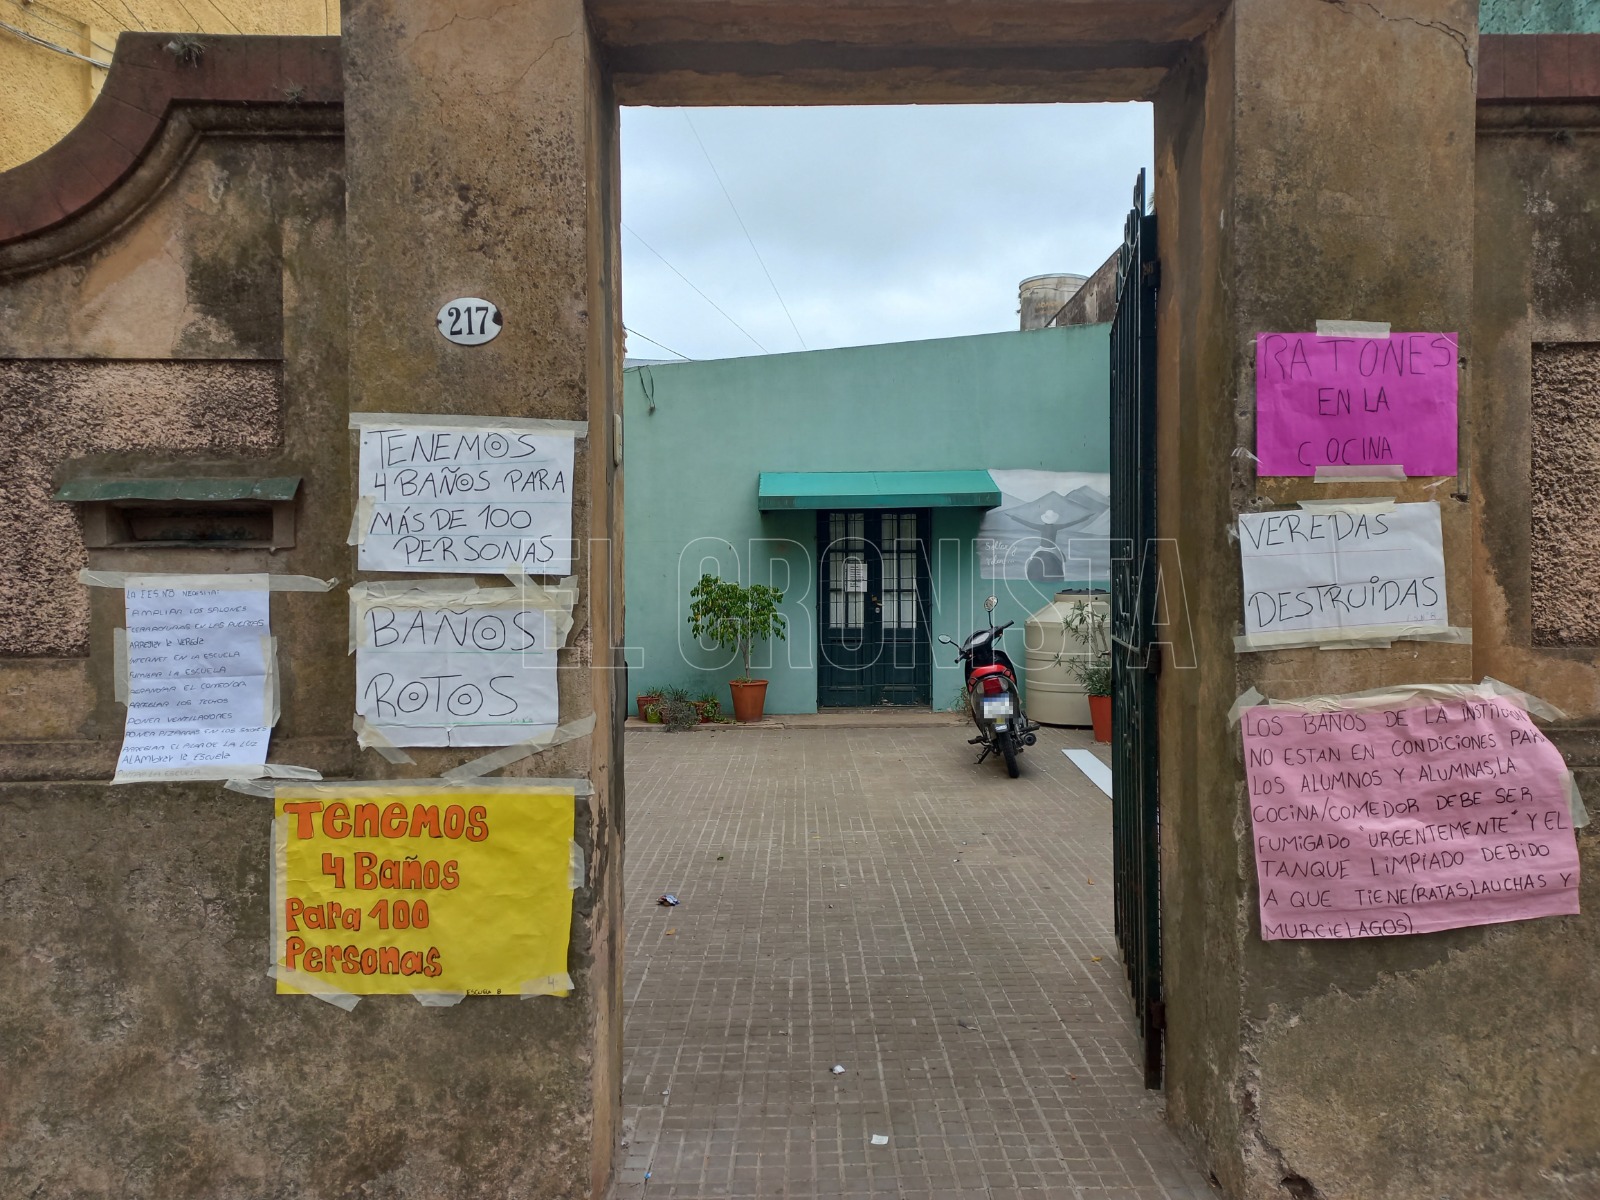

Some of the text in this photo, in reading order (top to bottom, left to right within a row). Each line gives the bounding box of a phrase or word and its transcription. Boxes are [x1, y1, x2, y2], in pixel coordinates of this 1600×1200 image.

[447, 306, 489, 336] 217
[1264, 334, 1451, 380] RATONES
[1318, 386, 1391, 416] EN LA
[367, 429, 536, 470] TENEMOS
[1297, 436, 1393, 467] COCINA
[374, 466, 566, 501] 4 BAÑOS PARA
[370, 504, 532, 535] MÁS DE 100
[1240, 510, 1389, 550] VEREDAS
[393, 534, 554, 565] PERSONAS
[207, 605, 248, 614] SALONES
[363, 605, 536, 652] BAÑOS
[185, 666, 227, 676] ESCUELA
[203, 651, 241, 660] ESCUELA
[364, 672, 519, 718] ROTOS
[127, 717, 161, 726] PONER
[1245, 711, 1284, 737] LOS
[1383, 709, 1409, 728] DE
[1425, 705, 1448, 725] LA
[1250, 748, 1274, 768] NO
[1284, 746, 1341, 766] ESTAN
[1351, 743, 1375, 761] EN
[1253, 775, 1285, 796] LOS
[1301, 769, 1383, 793] ALUMNOS
[1393, 767, 1405, 784] Y
[1436, 791, 1482, 811] DEBE
[1495, 786, 1533, 804] SER
[1526, 812, 1538, 832] Y
[1544, 810, 1569, 831] EL
[321, 851, 460, 890] 4 Baños
[1261, 858, 1350, 880] TANQUE
[1263, 888, 1279, 908] A
[1290, 889, 1333, 908] QUE
[1559, 872, 1572, 888] Y
[285, 897, 430, 932] Para 100
[285, 935, 443, 978] Personas
